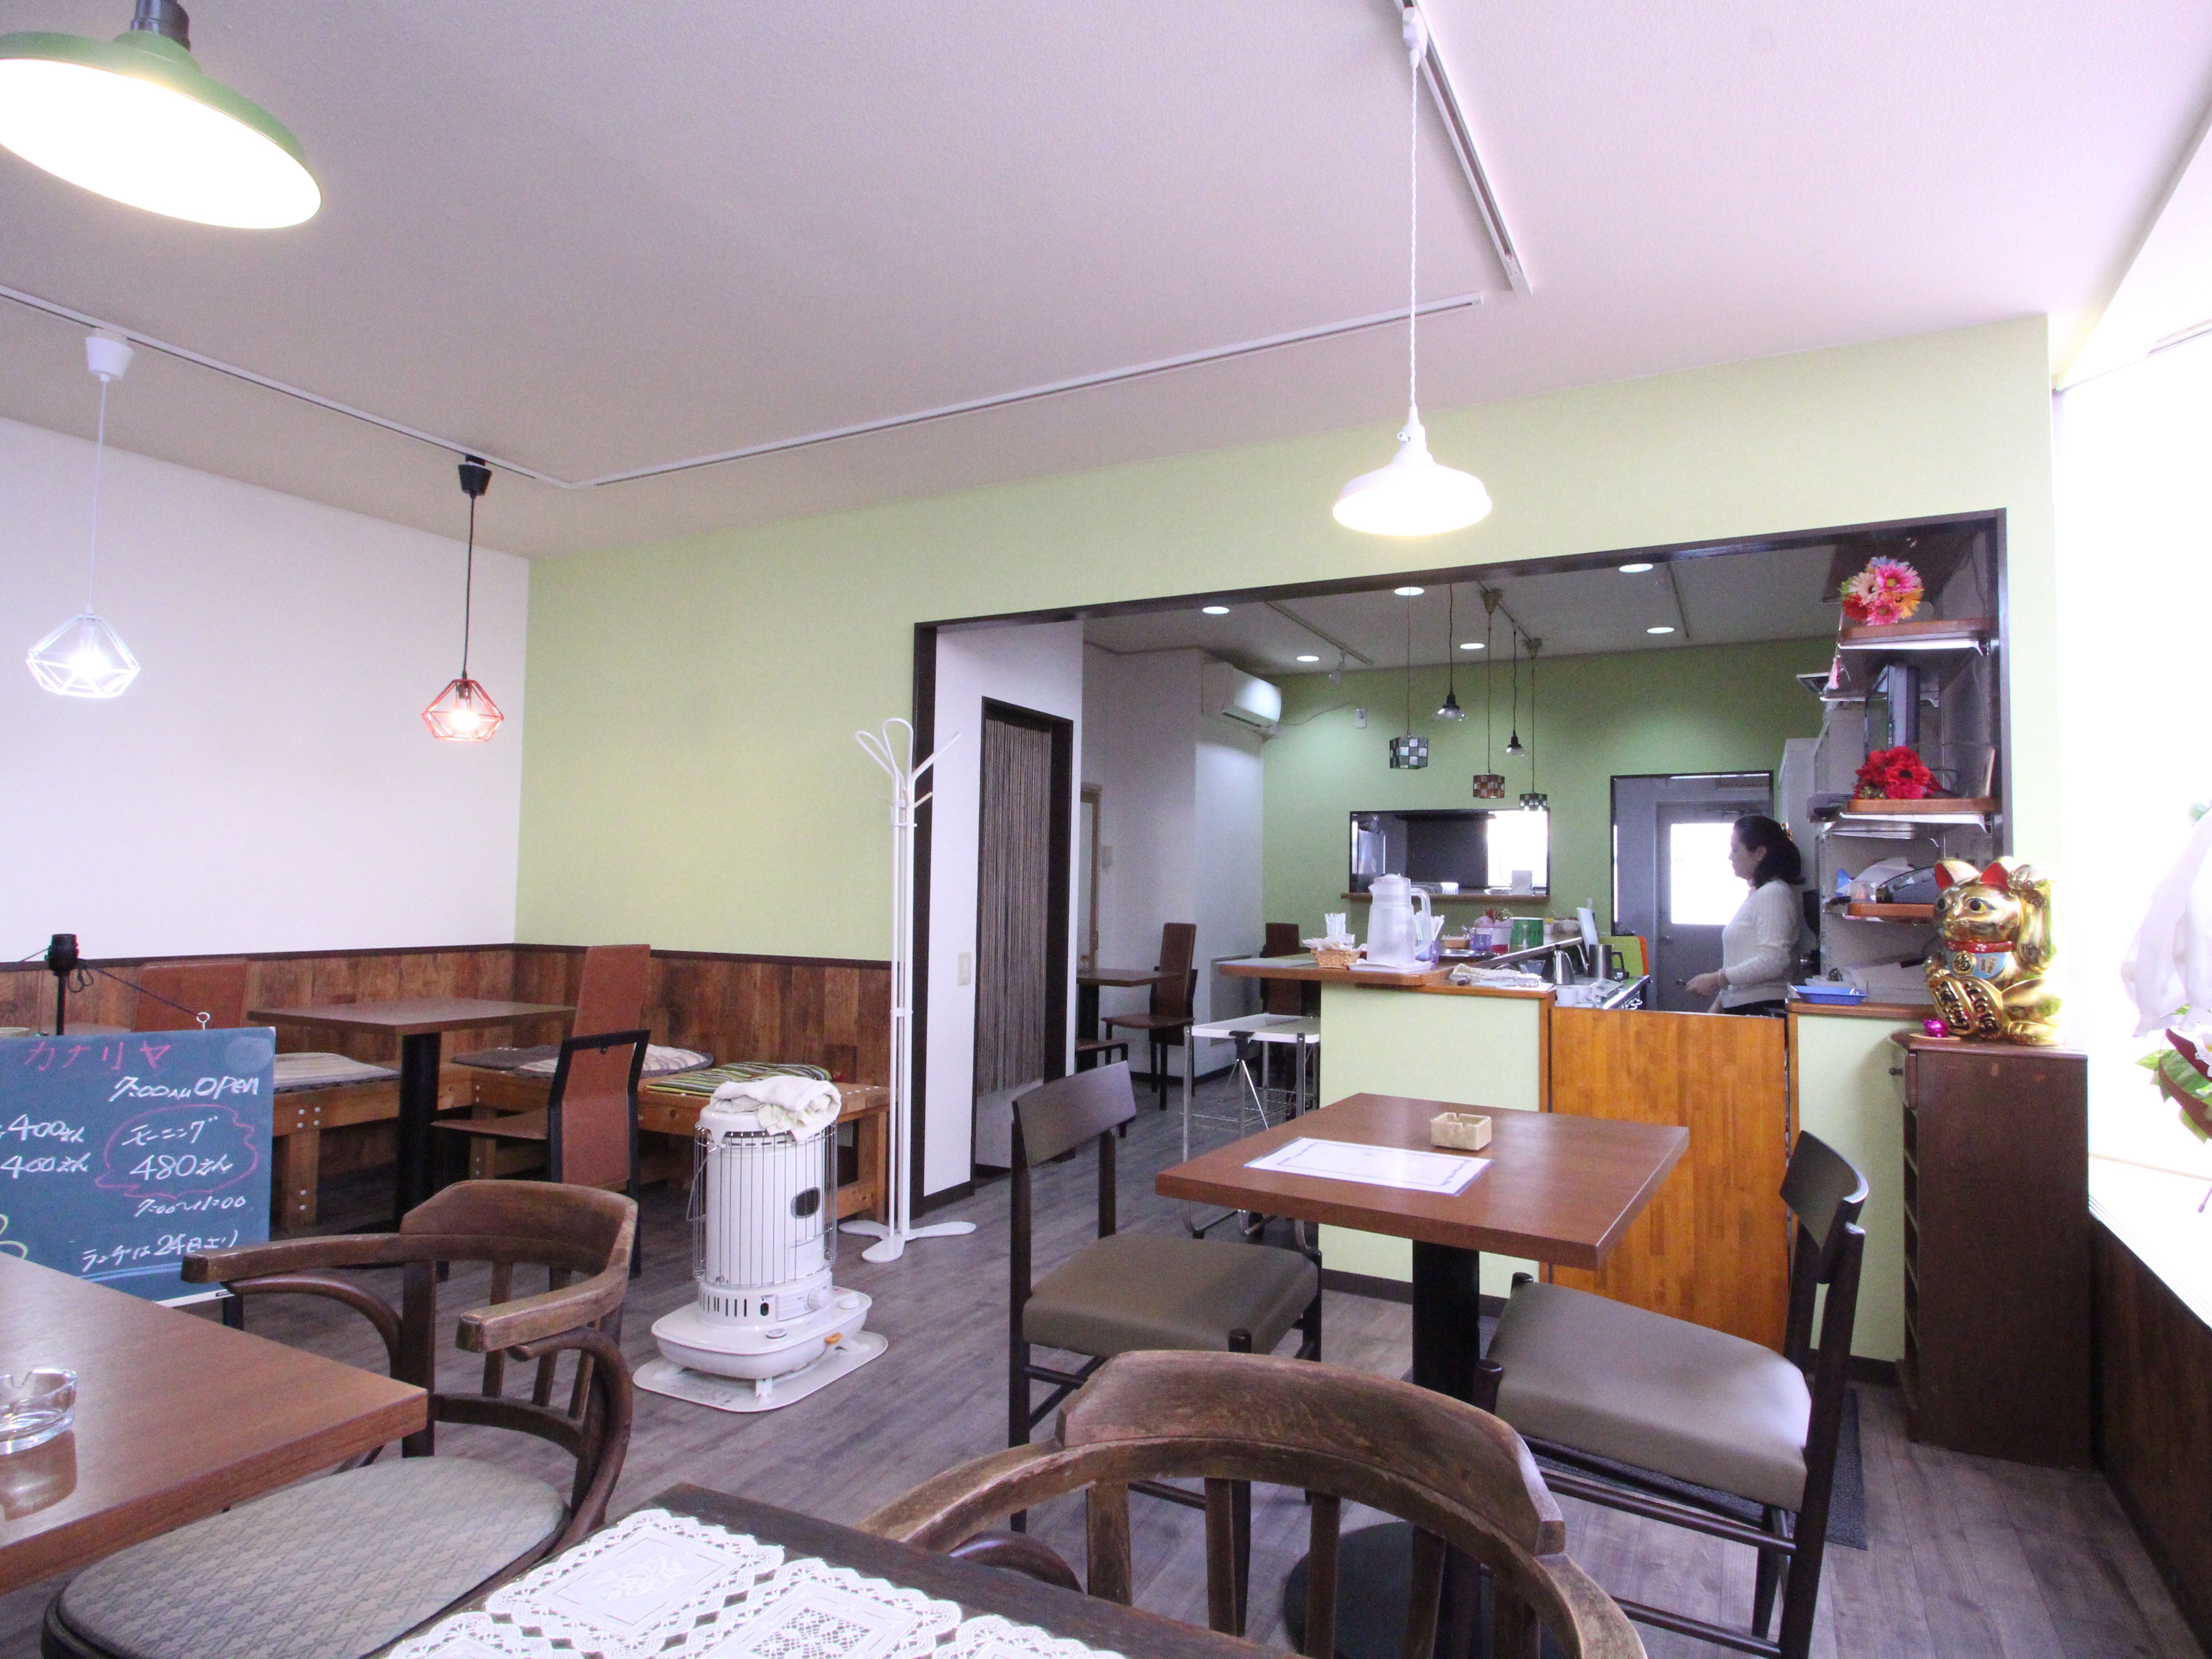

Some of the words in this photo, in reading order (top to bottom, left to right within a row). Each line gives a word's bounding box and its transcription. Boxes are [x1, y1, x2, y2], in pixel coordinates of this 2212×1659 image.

[24, 1041, 171, 1071] カナリヤ
[129, 1154, 233, 1180] 480えん
